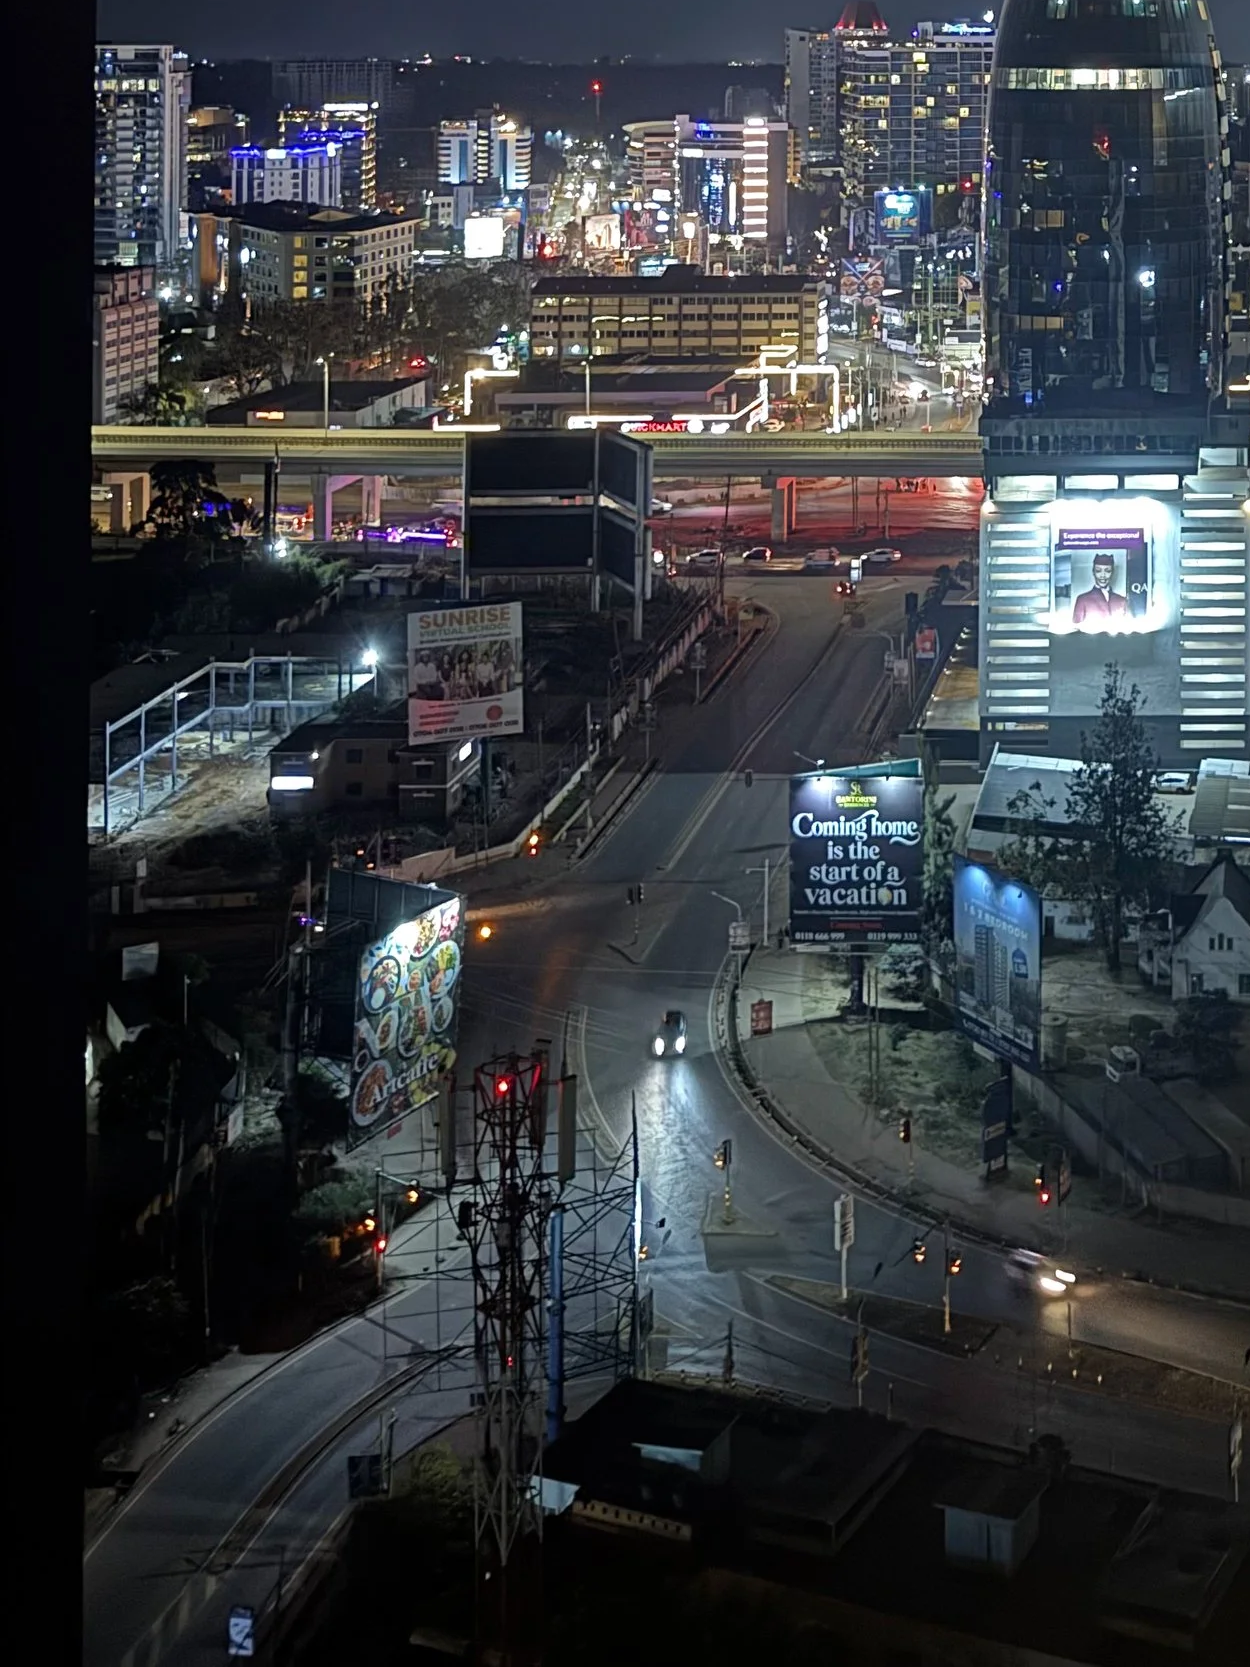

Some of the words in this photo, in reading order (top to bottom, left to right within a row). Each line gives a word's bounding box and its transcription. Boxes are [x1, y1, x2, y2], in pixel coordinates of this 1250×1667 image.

[419, 605, 511, 629] SUNRISE
[467, 623, 511, 632] SCHOOL
[792, 813, 868, 842] Coming
[863, 811, 920, 845] home
[827, 841, 844, 860] is
[848, 841, 880, 860] the
[809, 863, 860, 885] start
[863, 861, 886, 881] of
[885, 866, 904, 885] a
[804, 882, 907, 905] vacation
